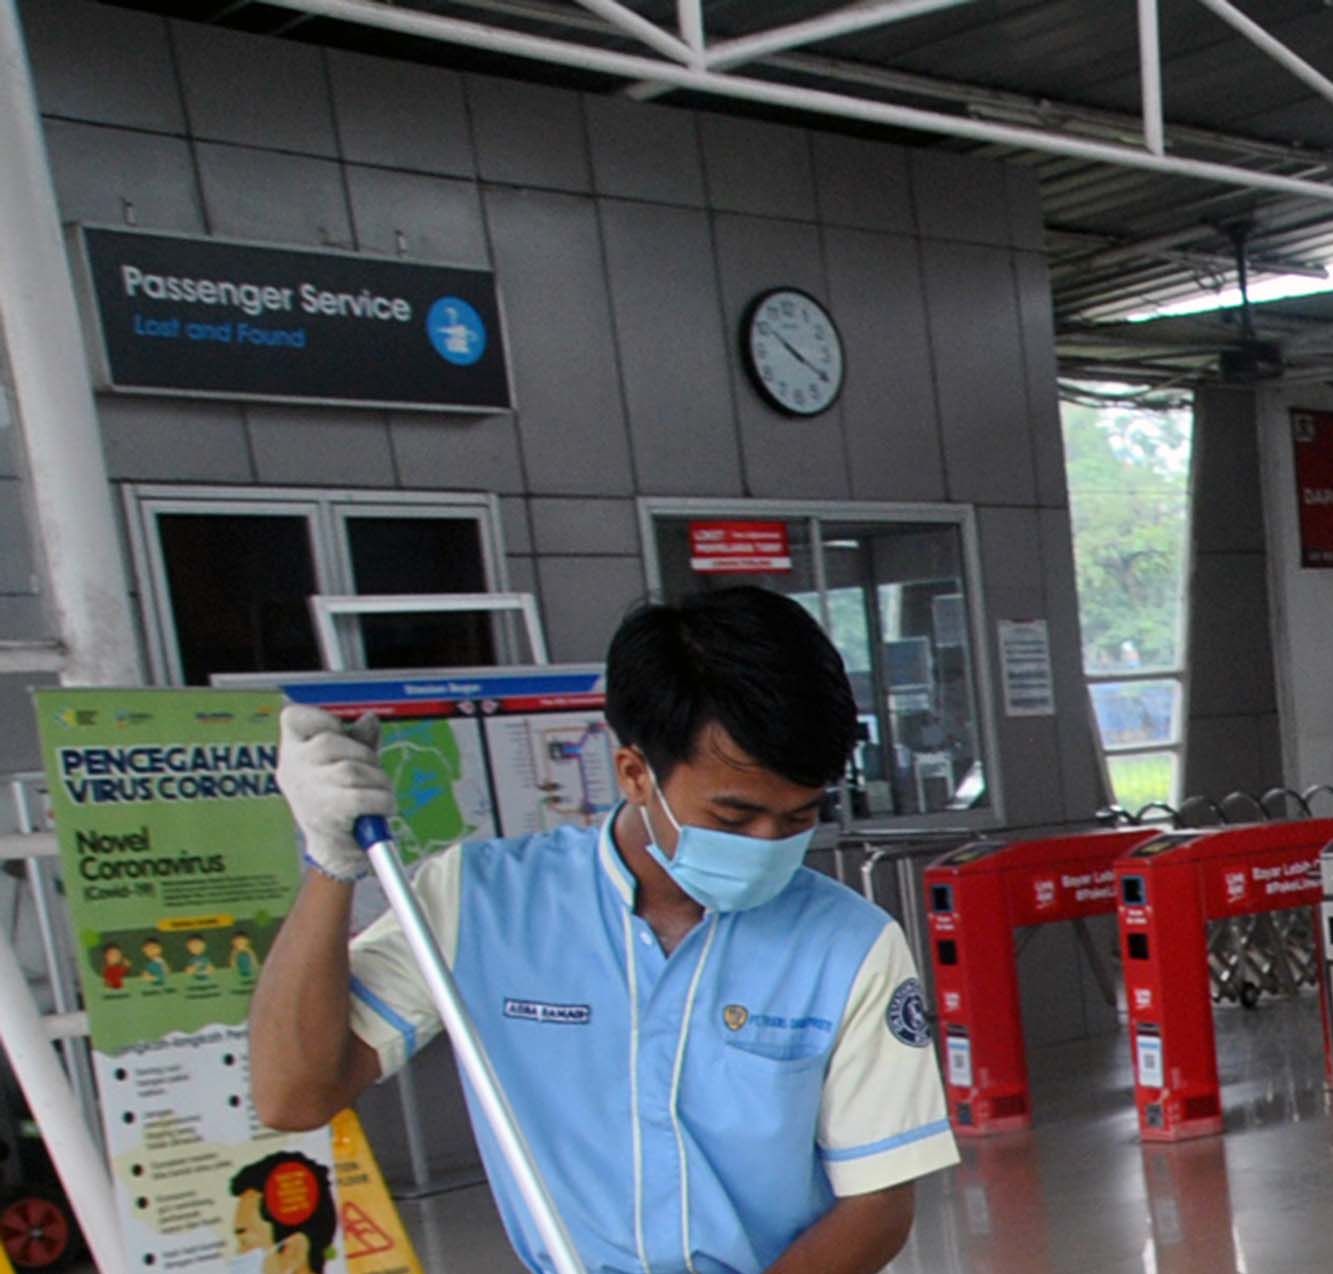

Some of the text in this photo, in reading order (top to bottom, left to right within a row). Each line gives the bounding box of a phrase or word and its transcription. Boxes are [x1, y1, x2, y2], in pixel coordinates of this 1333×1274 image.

[121, 264, 412, 322] Passenger Service
[133, 313, 306, 348] Lost and Found
[60, 746, 279, 777] PENCEGAHAN
[64, 773, 282, 804] VIRUS CORONA
[75, 827, 150, 855] Novel
[78, 851, 227, 882] Coronavirus
